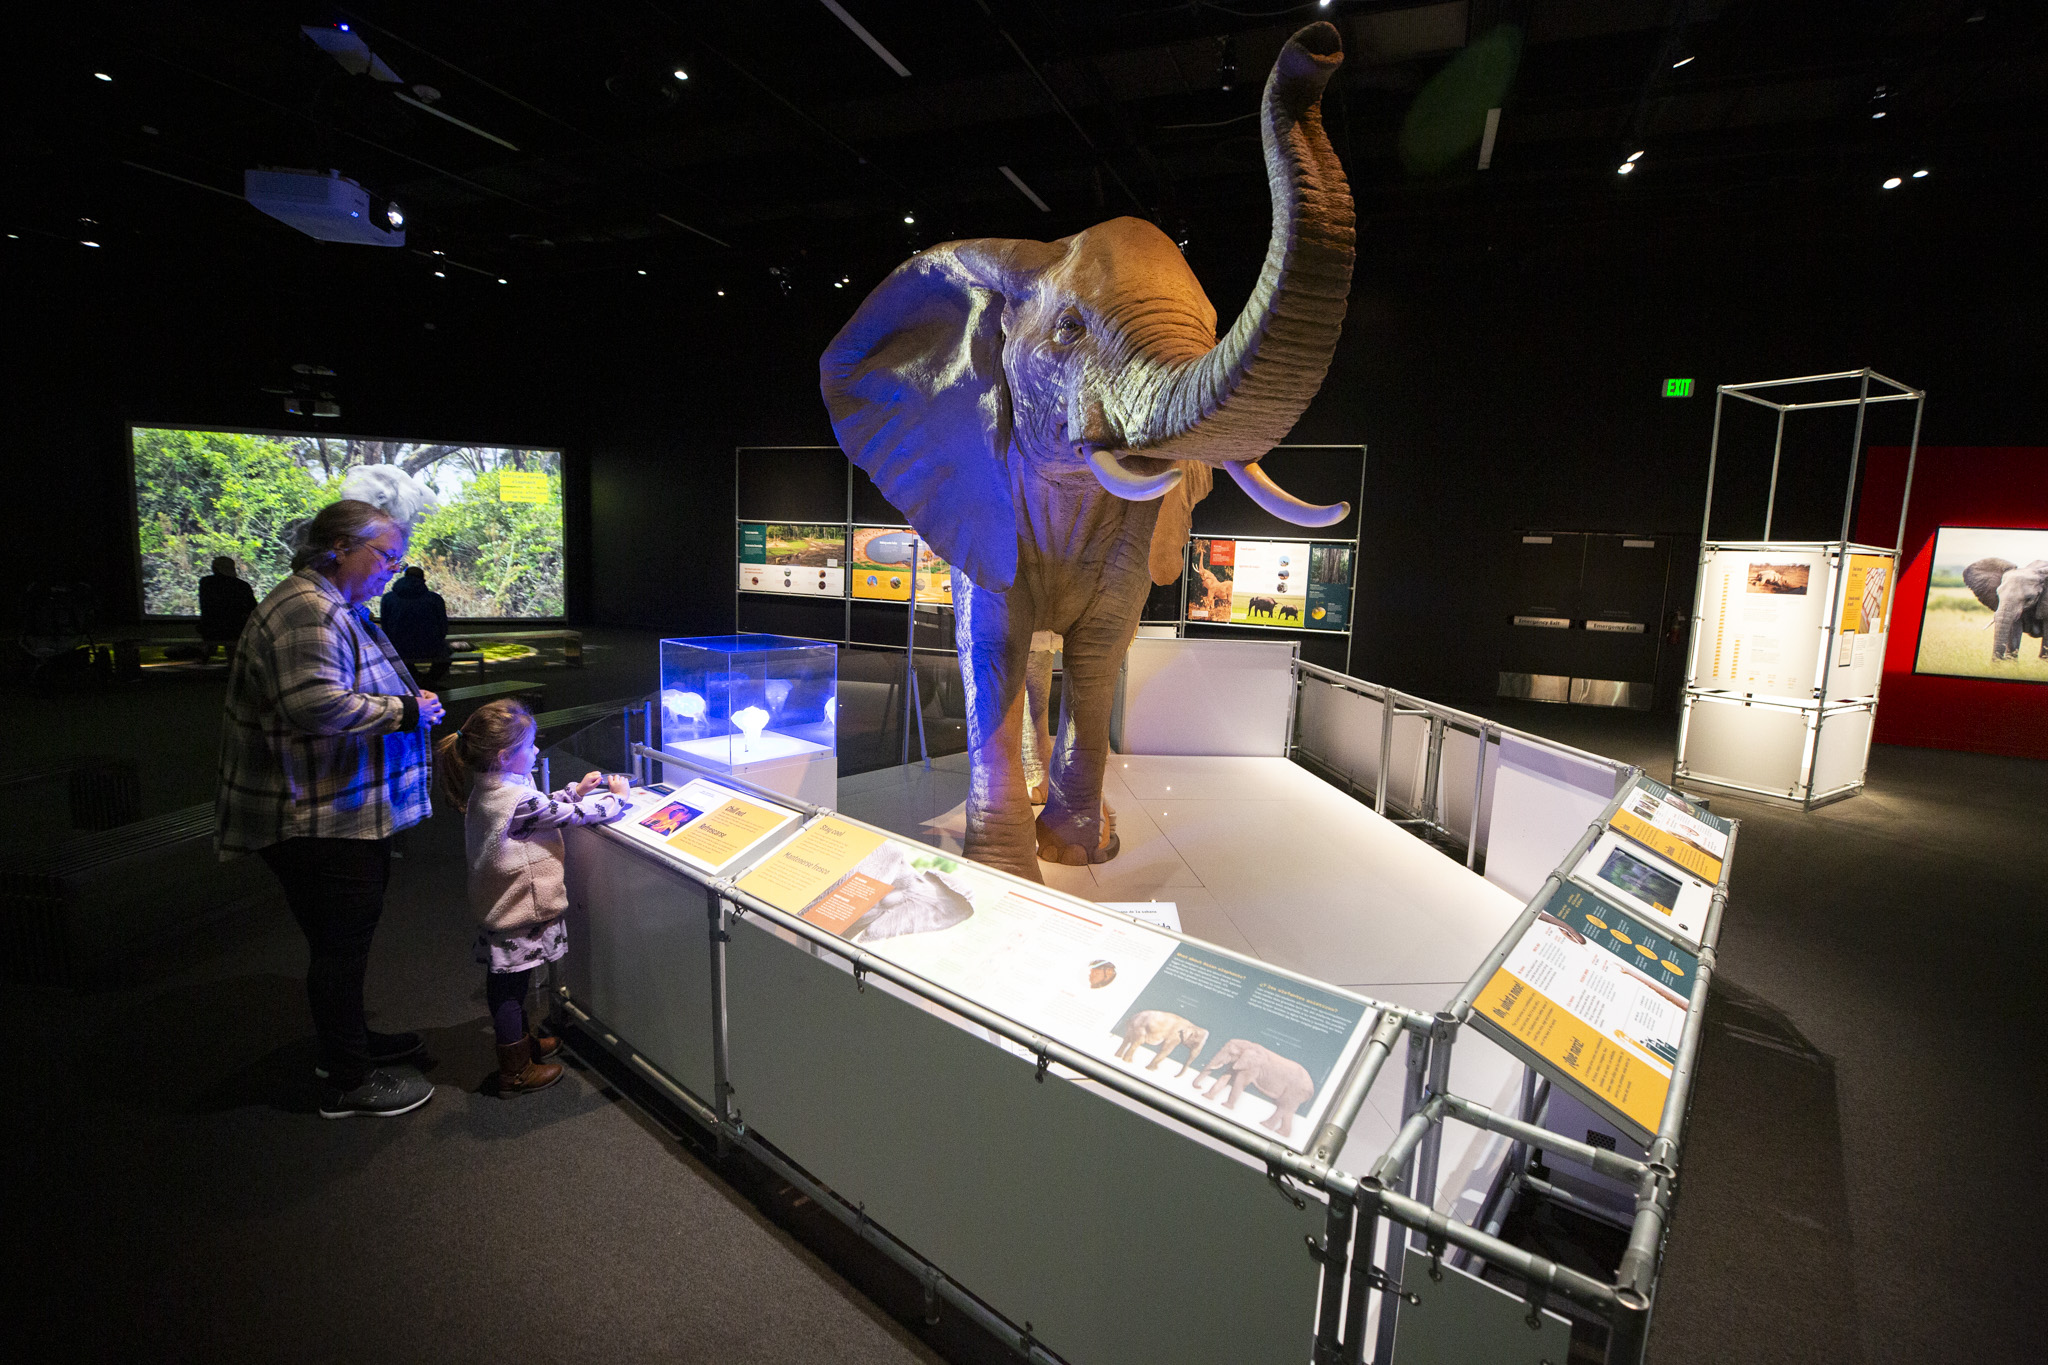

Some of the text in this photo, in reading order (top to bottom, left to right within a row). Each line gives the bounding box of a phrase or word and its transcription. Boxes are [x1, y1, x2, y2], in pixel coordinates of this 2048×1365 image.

[1667, 379, 1692, 396] EXIT
[1518, 618, 1548, 627] Emergency
[1593, 623, 1625, 631] Emergency
[820, 824, 846, 837] Stay cool
[783, 851, 830, 875] Mantenerse fresco
[1492, 980, 1525, 1019] Oh, what a nose!
[1570, 1035, 1585, 1056] nariz!
